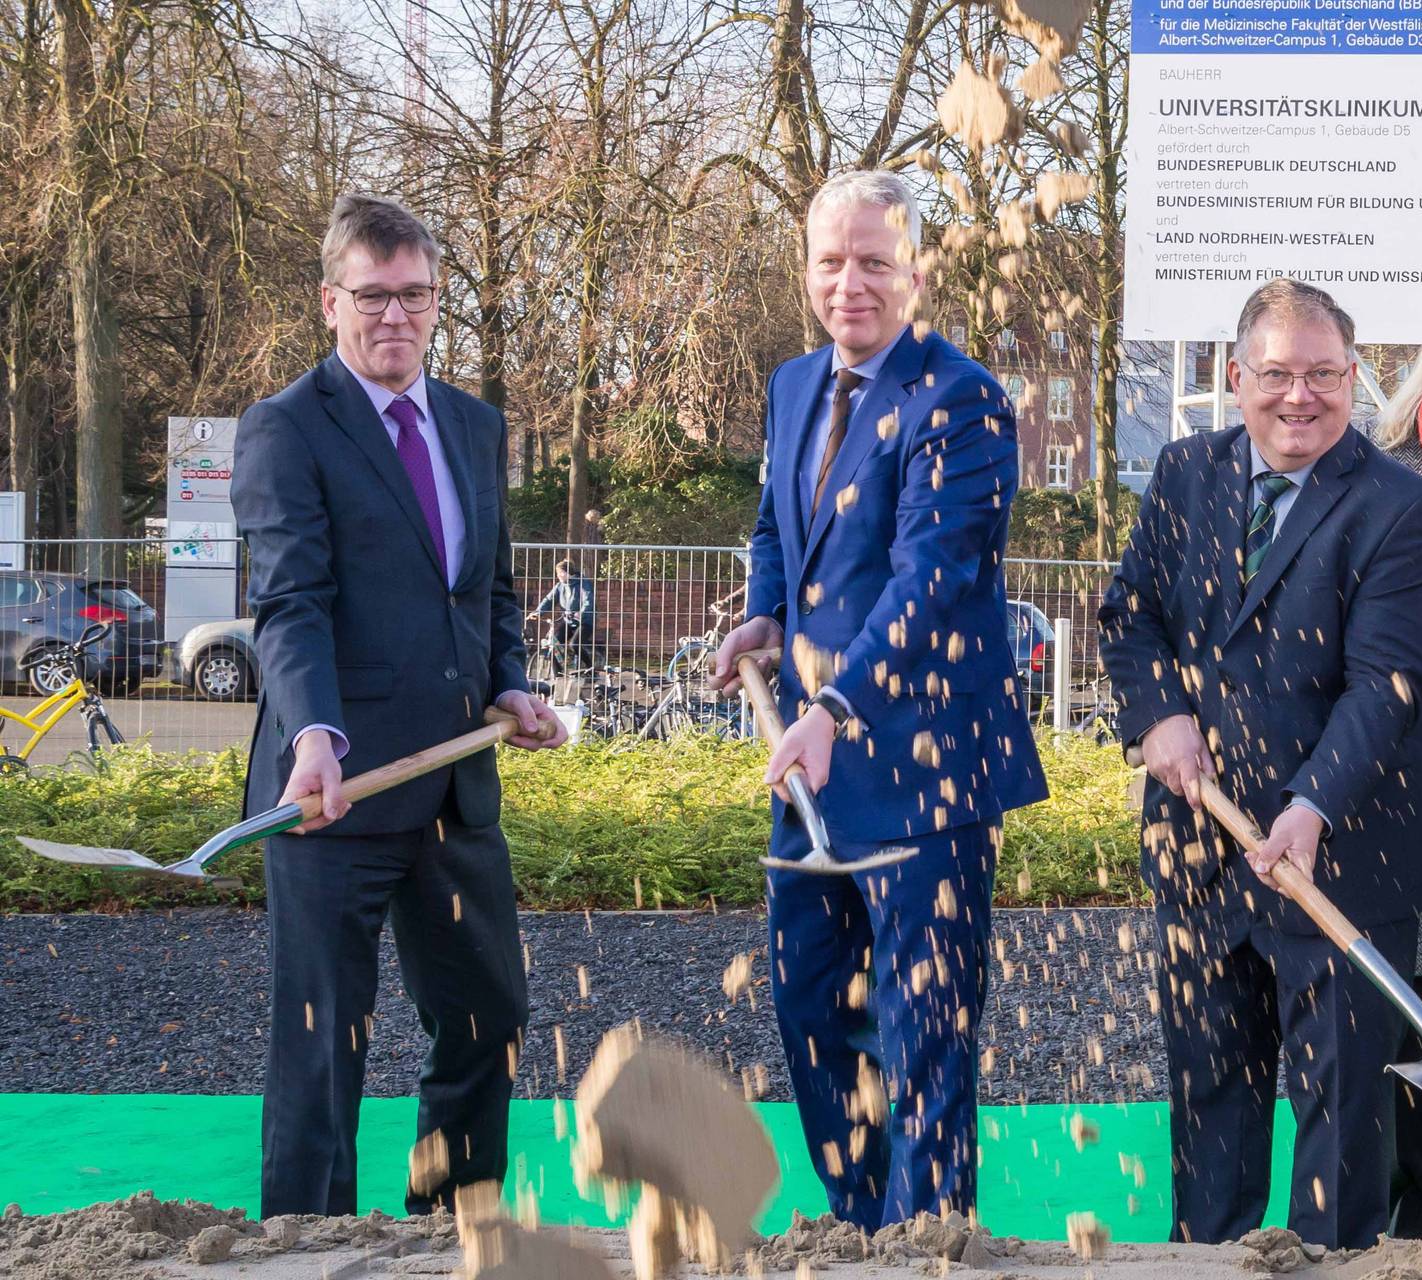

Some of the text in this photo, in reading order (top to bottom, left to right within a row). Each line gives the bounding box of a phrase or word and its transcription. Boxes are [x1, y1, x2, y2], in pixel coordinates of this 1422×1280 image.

[1160, 1, 1185, 10] und
[1188, 0, 1209, 10] der
[1213, 0, 1311, 12] Bundesrepublik
[1316, 0, 1395, 11] Deutschland
[1159, 18, 1178, 32] für
[1181, 18, 1200, 32] die
[1204, 18, 1287, 32] Medizinische
[1292, 18, 1342, 32] Fakultät
[1345, 18, 1367, 32] der
[1159, 34, 1326, 48] Albert-Schweitzer-Campus
[1331, 34, 1342, 48] 1,
[1346, 33, 1404, 47] Gebäude
[1159, 68, 1222, 81] BAUHERR
[1158, 123, 1411, 138] Albert-Schweitzer-Campus 1, Gebäude D5
[1157, 141, 1250, 156] gefördert durch
[1157, 159, 1397, 174] BUNDESREPUBLIK DEUTSCHLAND
[1156, 178, 1249, 191] vertreten durch
[1156, 196, 1313, 209] BUNDESMINISTERIUM
[1317, 194, 1346, 209] FÜR
[1350, 197, 1414, 210] BILDUNG
[1156, 213, 1179, 226] und
[1156, 232, 1194, 244] LAND
[1155, 251, 1247, 264] vertreten durch
[1155, 268, 1252, 281] MINISTERIUM
[1256, 267, 1284, 281] FÜR
[1288, 270, 1344, 282] KULTUR
[1348, 270, 1379, 283] UND
